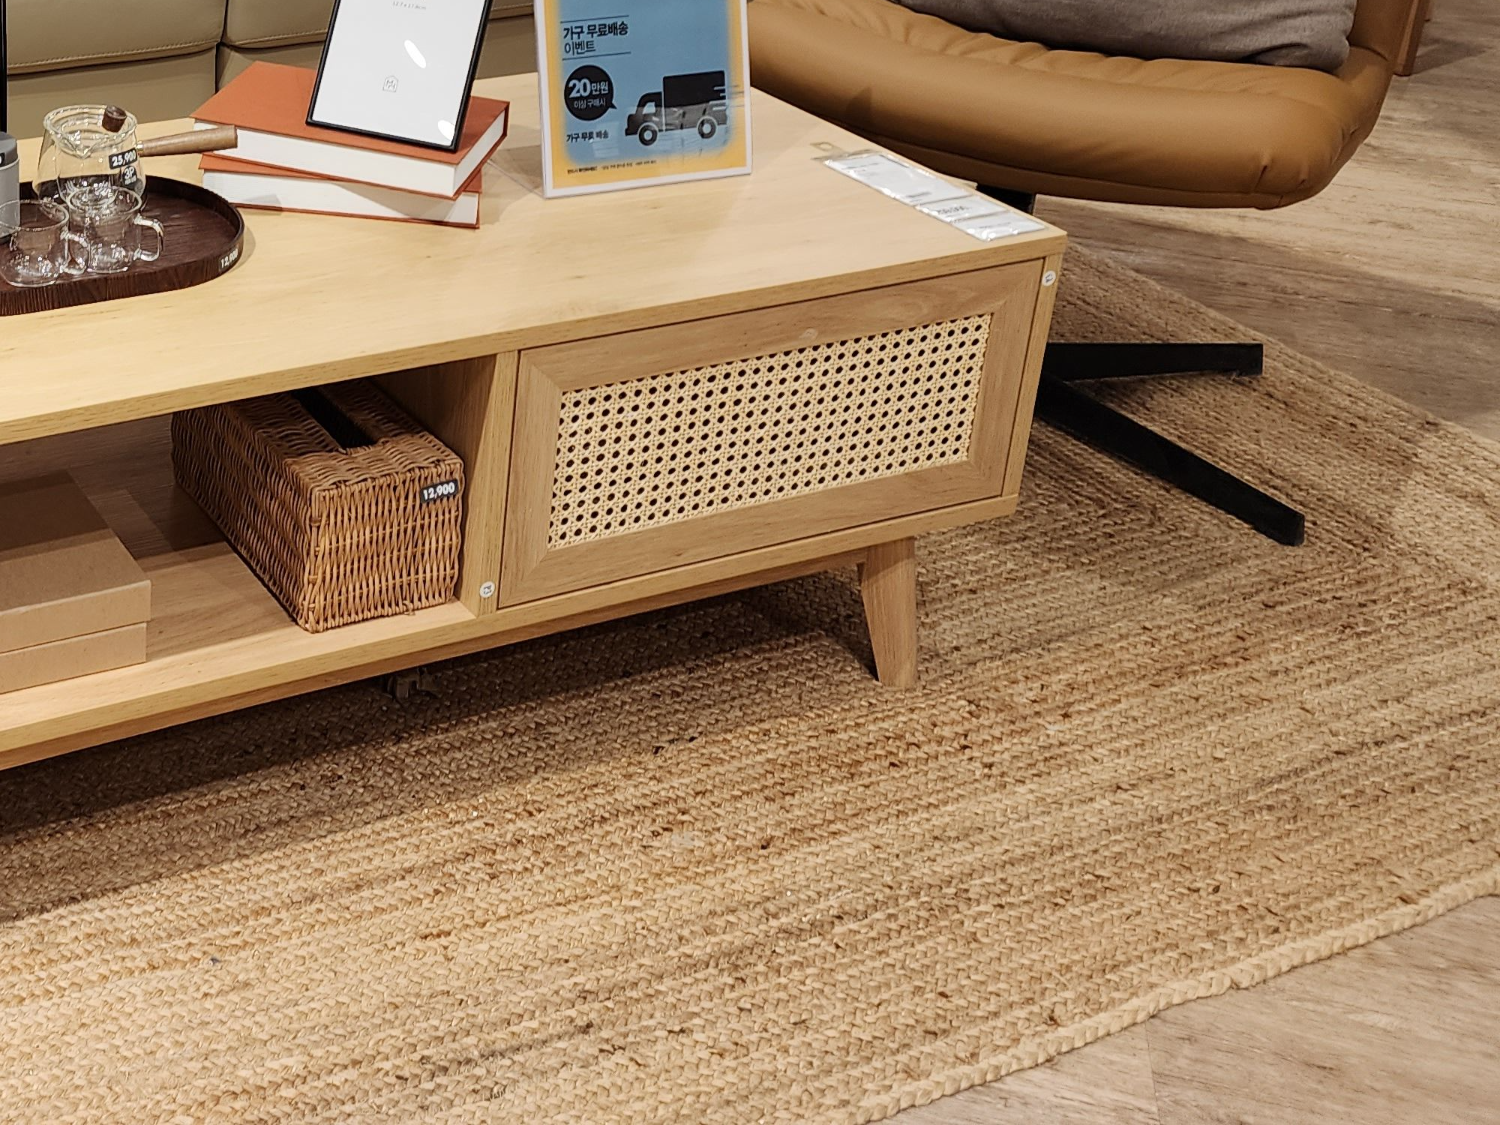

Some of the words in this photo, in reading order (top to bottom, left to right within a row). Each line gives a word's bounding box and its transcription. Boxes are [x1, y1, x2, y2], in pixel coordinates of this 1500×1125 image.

[563, 26, 588, 40] 가구
[586, 21, 629, 38] 무료배송
[564, 40, 596, 56] 이벤트
[568, 78, 609, 98] 20만원
[574, 100, 586, 109] 이상
[566, 133, 580, 143] 가구
[111, 151, 136, 167] 25,900
[422, 482, 455, 501] 12,900
